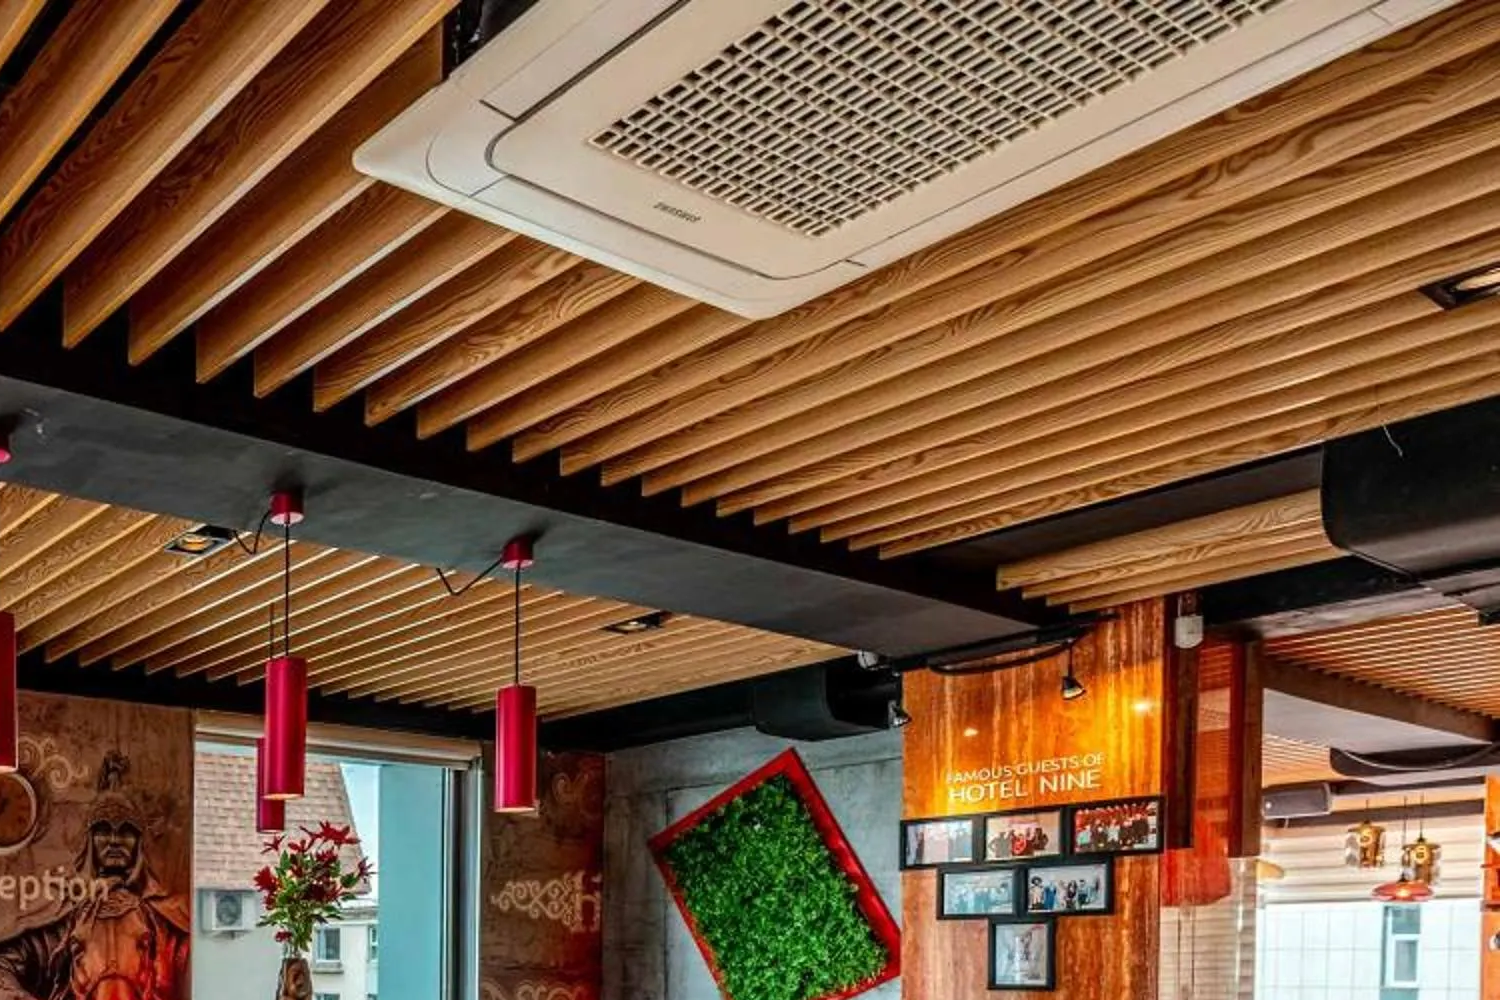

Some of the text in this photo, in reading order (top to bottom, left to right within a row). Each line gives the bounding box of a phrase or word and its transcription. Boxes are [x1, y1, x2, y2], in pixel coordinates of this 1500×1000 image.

[947, 752, 1104, 784] FAMOUS GUESTS OF
[949, 767, 1102, 804] HOTEL NINE
